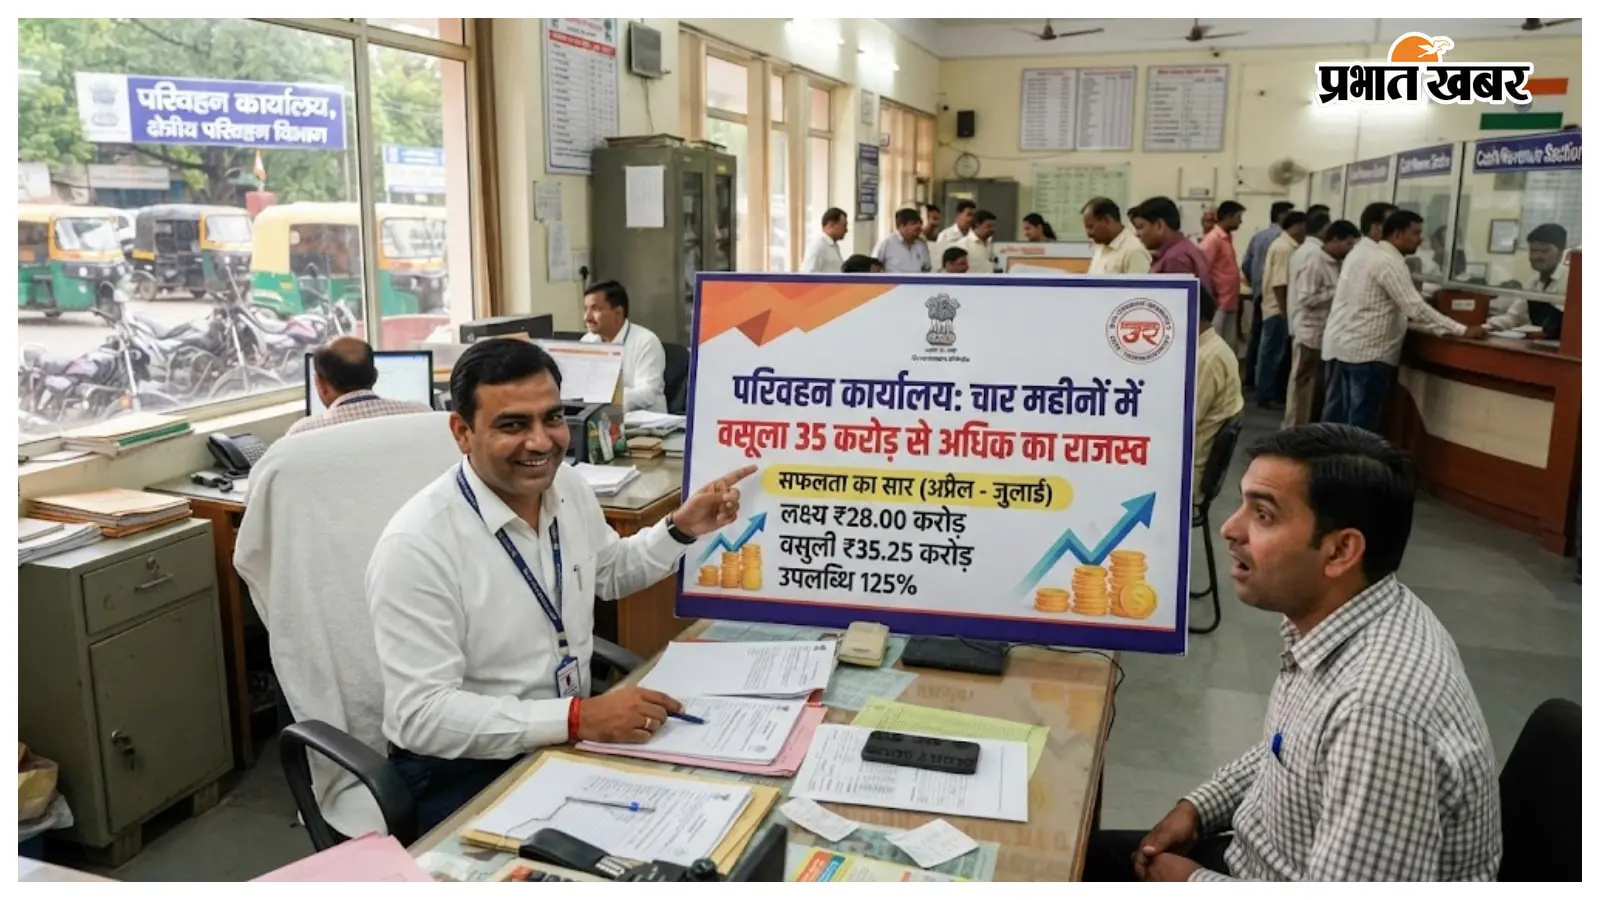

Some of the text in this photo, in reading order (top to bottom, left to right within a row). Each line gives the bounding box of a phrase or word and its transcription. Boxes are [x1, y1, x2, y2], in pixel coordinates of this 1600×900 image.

[136, 81, 230, 114] परिवहन
[732, 366, 1146, 418] परिवहन कार्यालय: चार महीनों में
[717, 416, 1151, 466] वसूला 35 करोड़ से अधिक का राजस्व
[778, 471, 848, 493] सफलता
[852, 474, 877, 495] का
[882, 476, 916, 497] सार
[780, 503, 968, 540] लक्ष्य ₹28.00 करोड़
[843, 537, 914, 563] ₹35.25
[918, 537, 976, 573] करोड़
[860, 572, 918, 596] 125%
